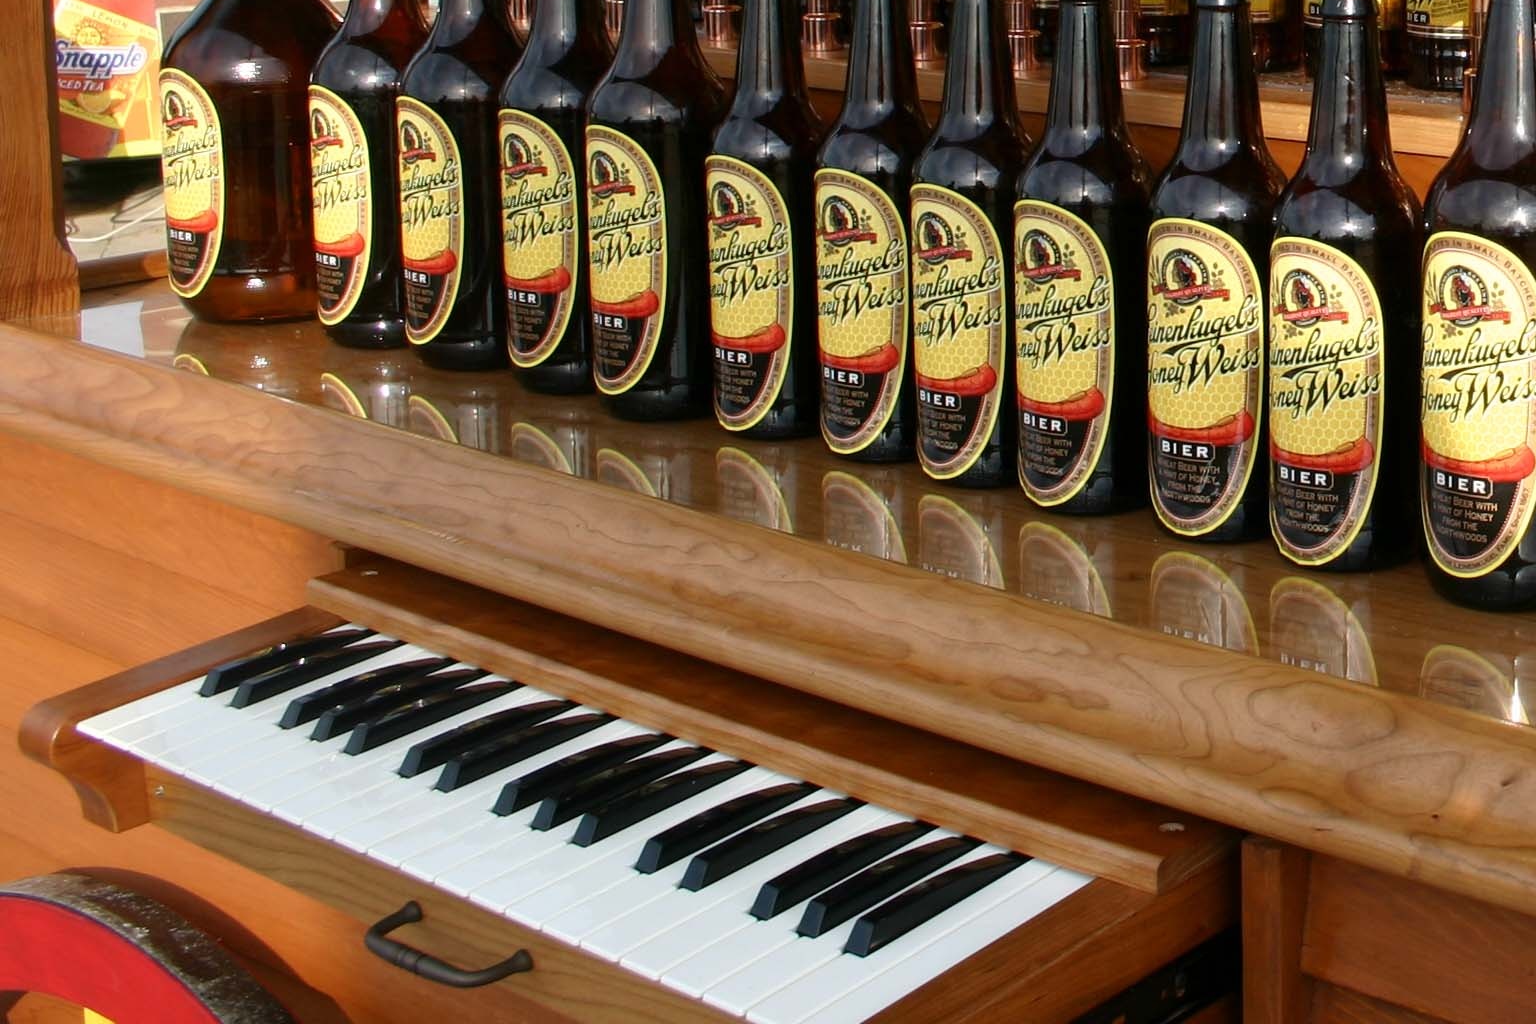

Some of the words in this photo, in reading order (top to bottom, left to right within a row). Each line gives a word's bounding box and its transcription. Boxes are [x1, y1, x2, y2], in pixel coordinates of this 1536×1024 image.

[929, 301, 1001, 345] Weiss
[1035, 322, 1111, 367] Weiss
[823, 365, 860, 385] BIER
[1178, 343, 1260, 390] Weiss
[920, 389, 956, 407] BIER
[1296, 367, 1380, 416] Weiss
[1023, 412, 1063, 432] BIER
[1162, 440, 1209, 458] BIER
[1280, 466, 1327, 486] BIER
[1436, 471, 1487, 494] BIER
[1465, 510, 1495, 523] HONEY
[1476, 502, 1499, 512] WITH
